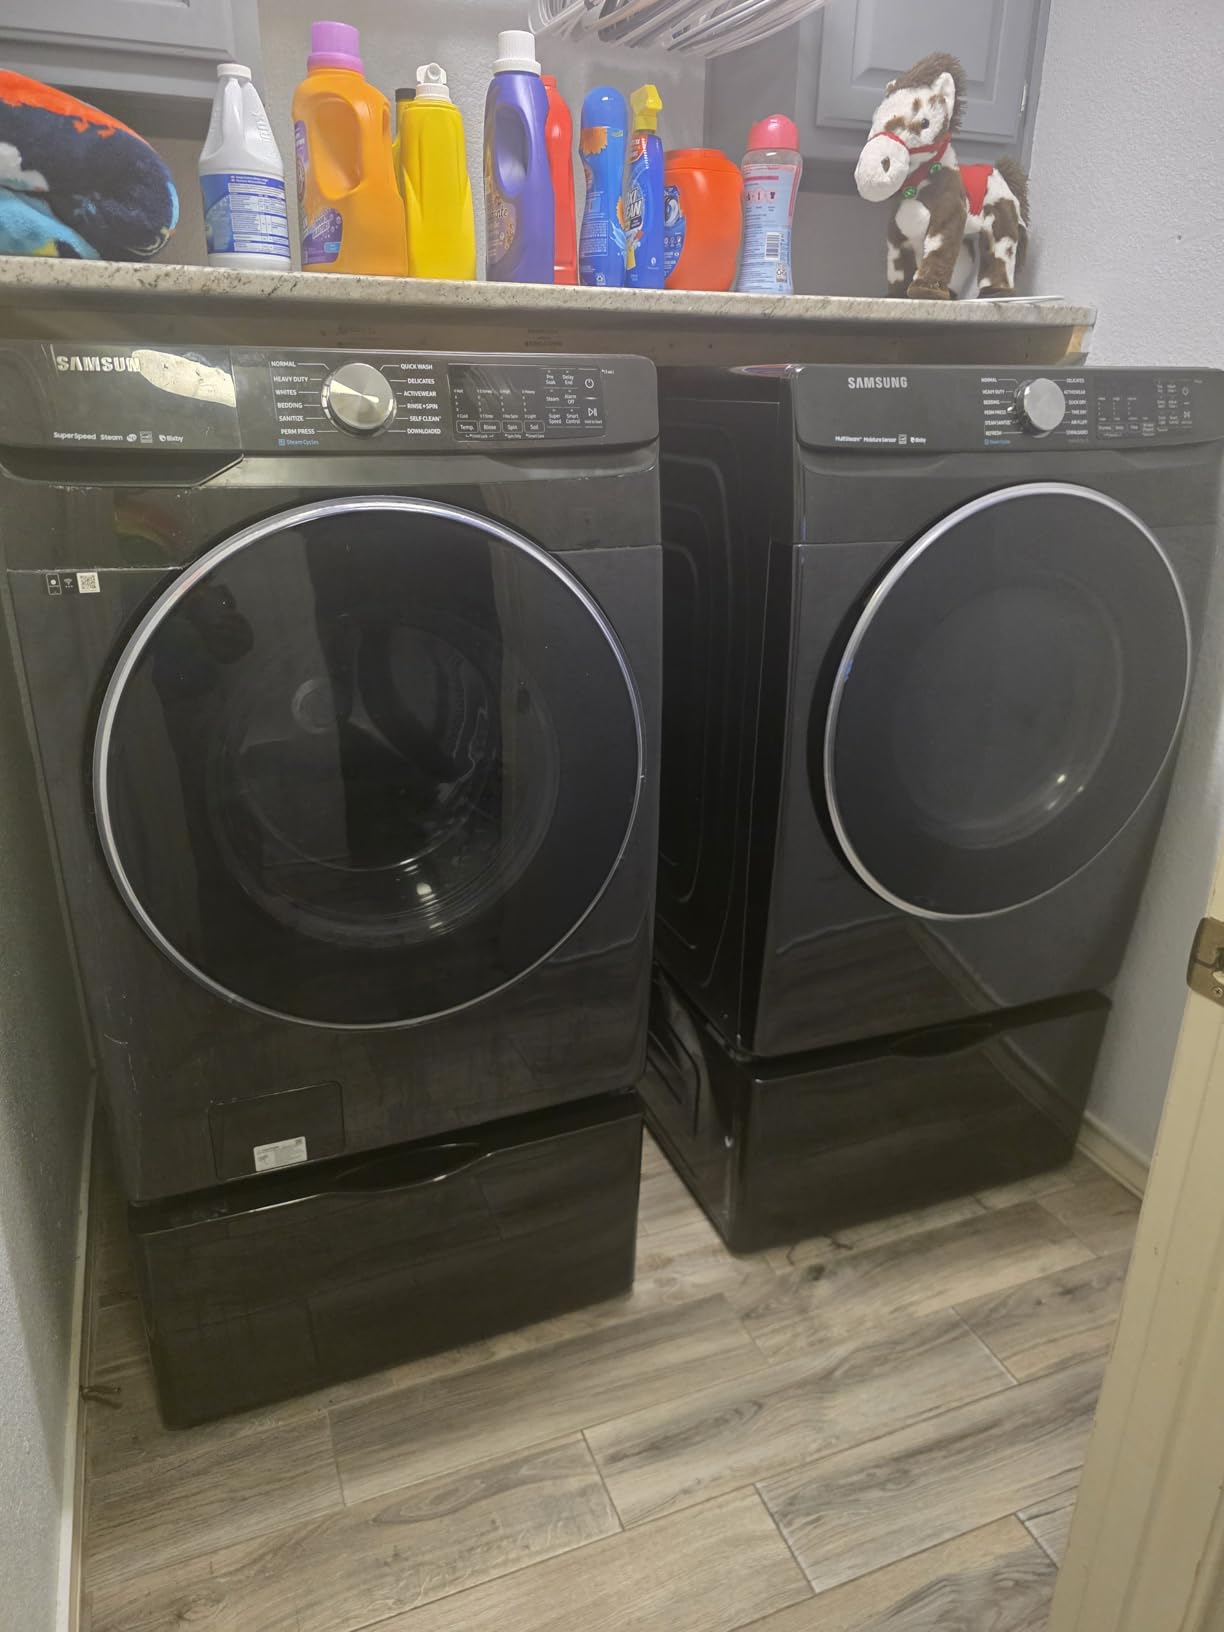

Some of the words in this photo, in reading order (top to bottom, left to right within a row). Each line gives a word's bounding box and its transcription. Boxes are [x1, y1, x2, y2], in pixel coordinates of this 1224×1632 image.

[56, 356, 141, 372] SAMSUN
[848, 376, 908, 389] SAMSUNG
[100, 433, 123, 441] Steam
[166, 434, 184, 443] Bixby
